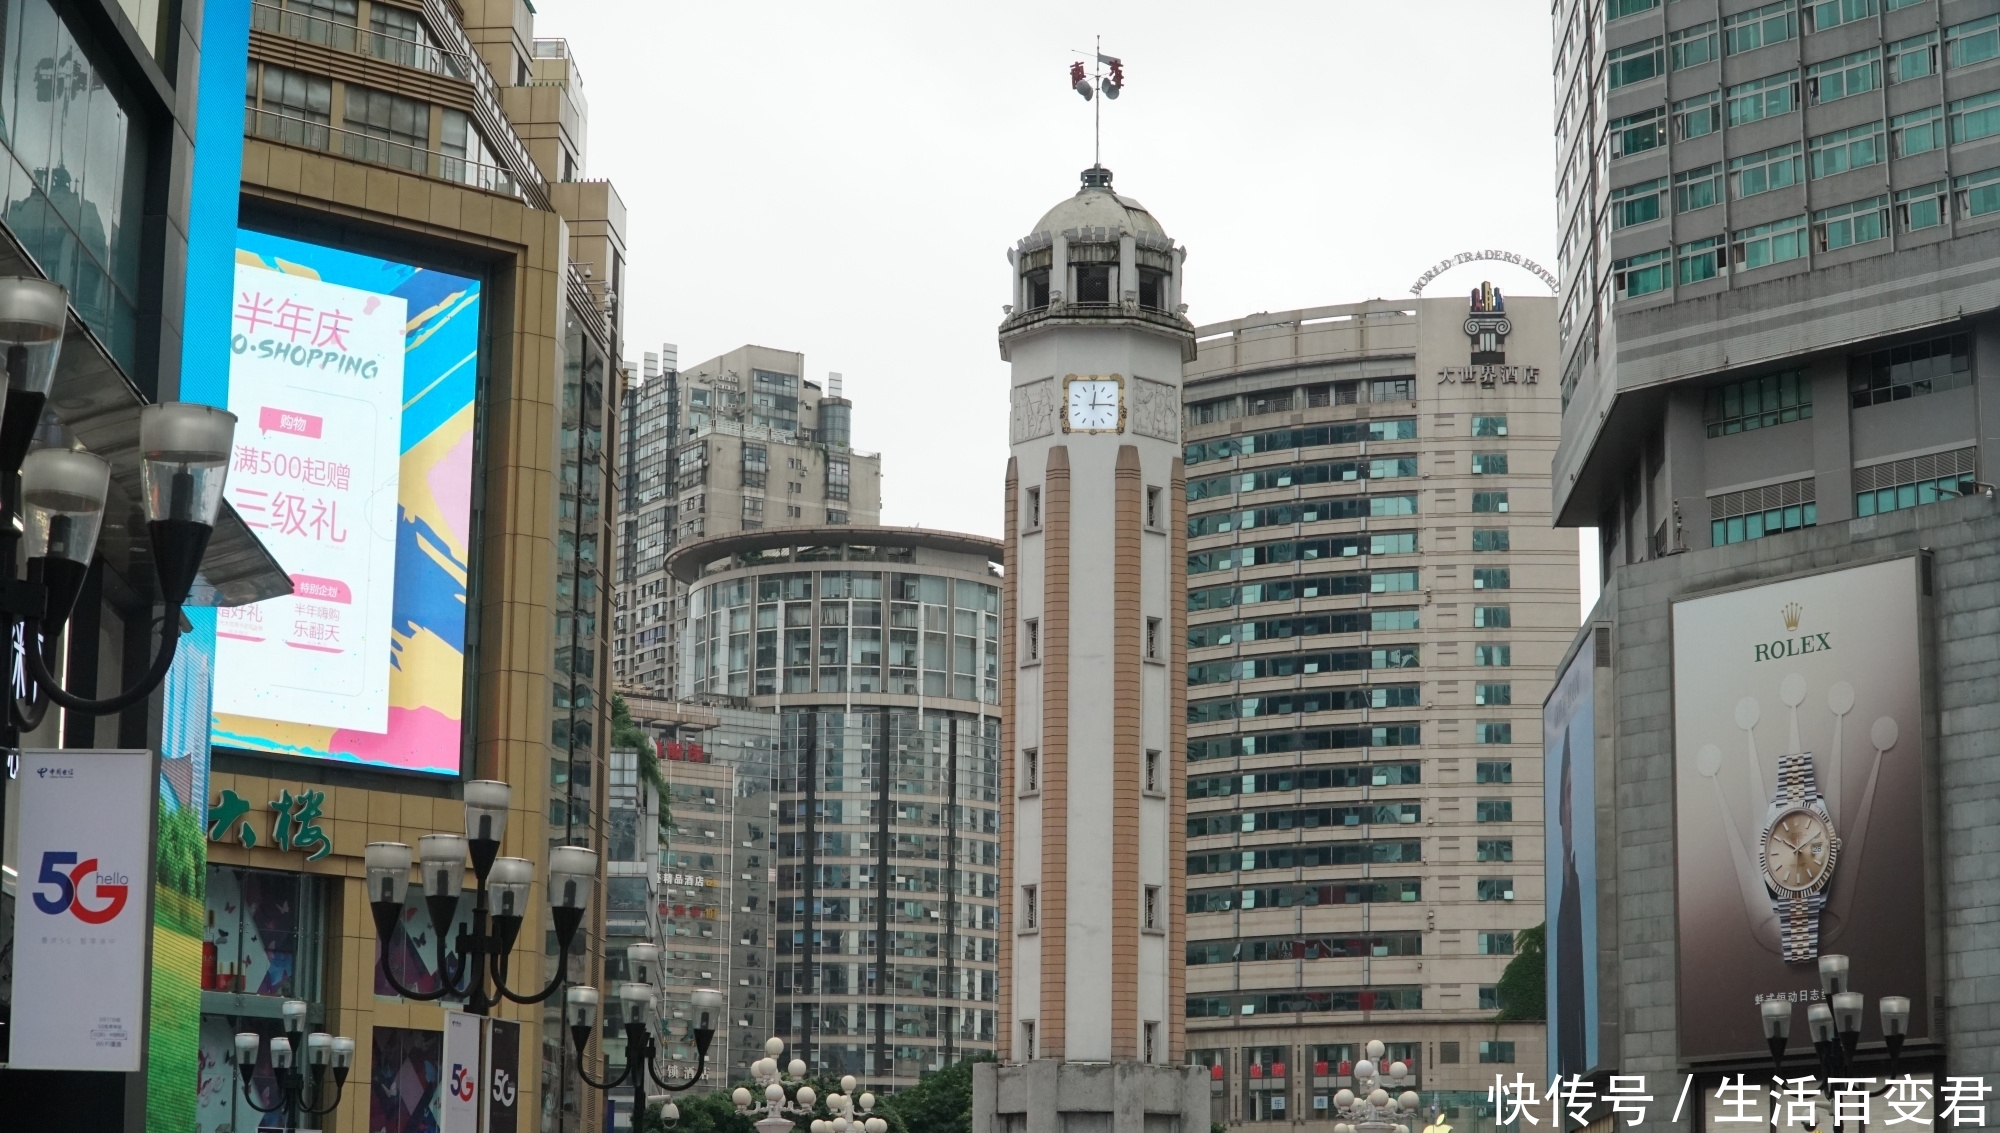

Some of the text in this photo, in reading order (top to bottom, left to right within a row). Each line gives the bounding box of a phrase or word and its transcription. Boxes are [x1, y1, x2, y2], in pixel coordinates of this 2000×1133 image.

[1409, 249, 1560, 295] WORLD TRADERS HOTEL
[234, 291, 353, 352] 半年庆
[1437, 365, 1540, 385] 大世界酒店
[279, 414, 307, 432] 购物
[233, 444, 351, 492] 满500起赠
[235, 488, 347, 543] 三级礼
[300, 581, 338, 598] 特别企划
[293, 620, 341, 642] 乐翻天
[294, 603, 341, 622] 半年嗨购
[1754, 632, 1832, 662] ROLEX
[208, 789, 331, 862] 大楼
[32, 851, 129, 924] 5G
[95, 872, 129, 885] hello
[450, 1063, 474, 1102] 5G
[493, 1069, 516, 1107] 5G
